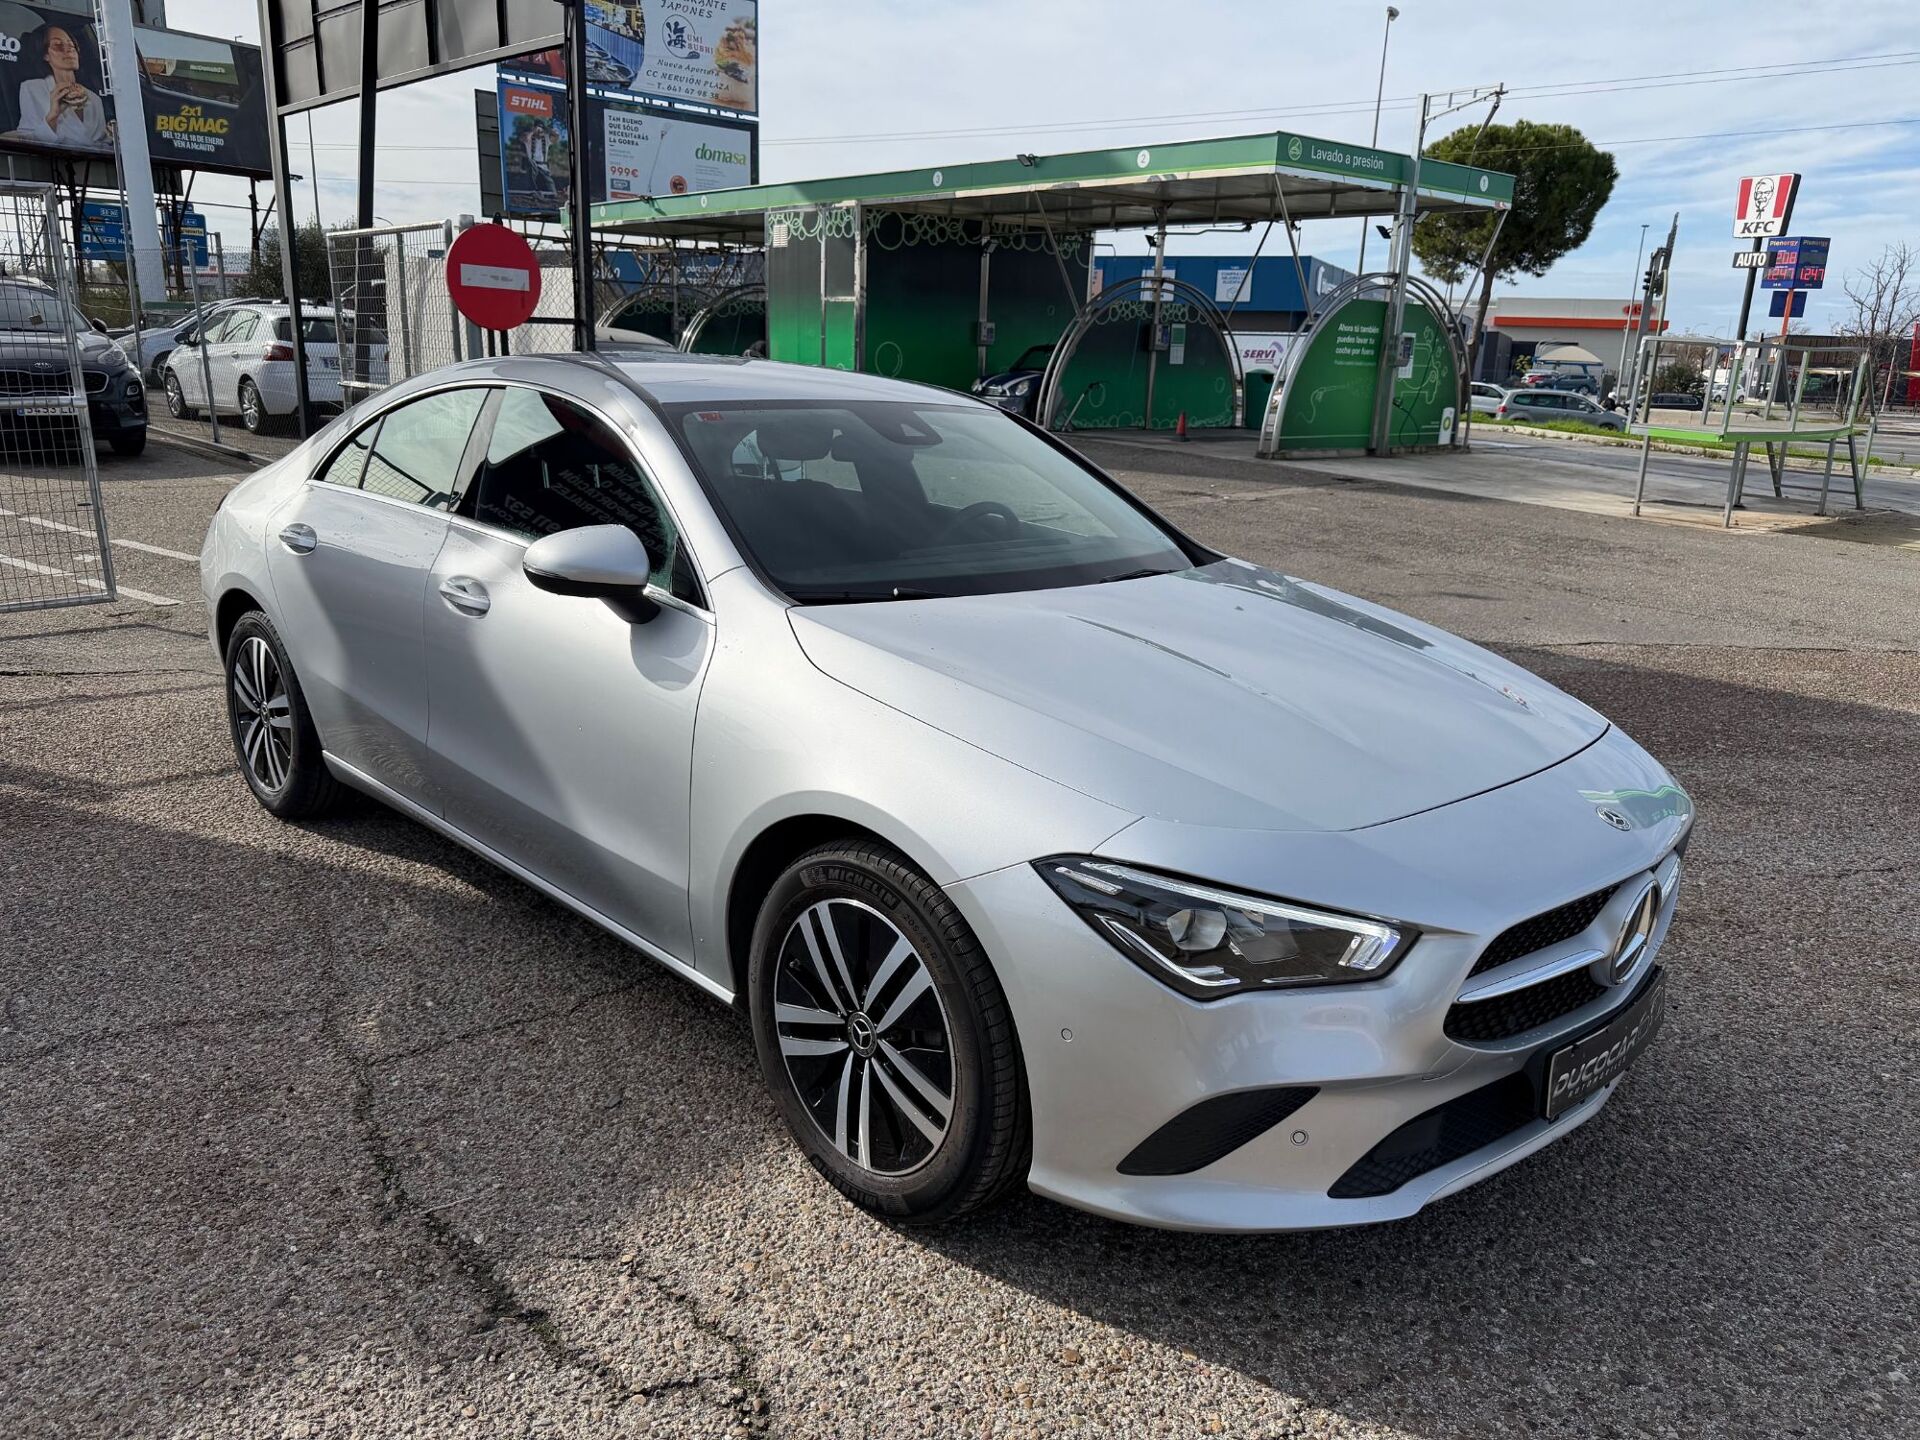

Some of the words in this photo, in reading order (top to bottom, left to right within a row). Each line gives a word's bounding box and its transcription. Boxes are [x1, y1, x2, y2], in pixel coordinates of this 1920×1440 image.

[661, 0, 713, 18] JAPONES
[687, 34, 703, 43] UMI
[657, 59, 682, 69] Nueva
[684, 64, 719, 76] Apertura
[646, 70, 658, 78] CC
[703, 80, 730, 92] PLAZA
[511, 95, 548, 111] STIHL
[181, 105, 202, 116] 2x1
[157, 115, 187, 132] BIG
[189, 117, 230, 134] MAC
[622, 117, 643, 126] BUENO
[623, 124, 639, 132] SÓLO
[163, 131, 174, 139] DEL
[197, 135, 204, 143] DE
[205, 137, 224, 146] ENERO
[608, 130, 649, 141] NECESITARÁS
[173, 140, 186, 148] VEN
[695, 143, 747, 165] domasa
[1311, 145, 1343, 163] Lavado
[1345, 154, 1351, 164] a
[1352, 155, 1384, 170] presión
[610, 166, 639, 178] 999€
[1740, 221, 1775, 234] KFC
[1736, 252, 1767, 267] AUTO
[1337, 323, 1353, 332] Ahora
[1243, 349, 1276, 358] SERVI
[828, 868, 898, 908] MICHELIN
